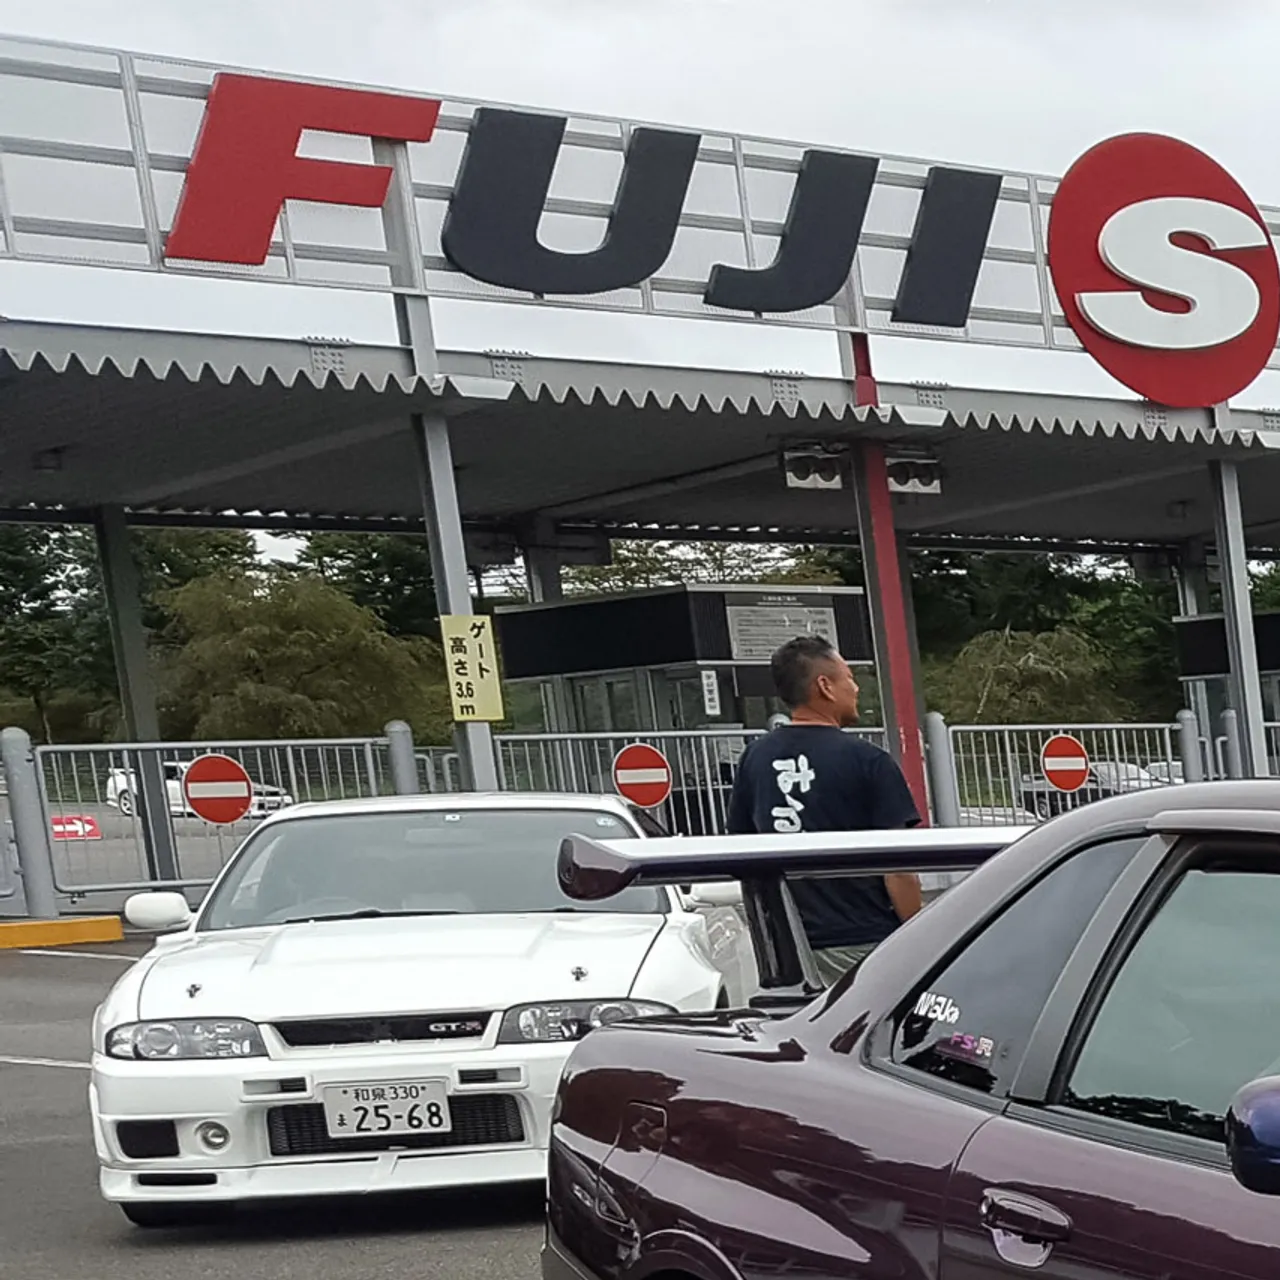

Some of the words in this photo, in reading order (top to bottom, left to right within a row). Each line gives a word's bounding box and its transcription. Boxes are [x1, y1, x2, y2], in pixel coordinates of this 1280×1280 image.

[164, 72, 1003, 328] FUJI
[469, 621, 491, 679] ゲート
[429, 1021, 482, 1032] GT-R
[353, 1102, 444, 1133] 25-68
